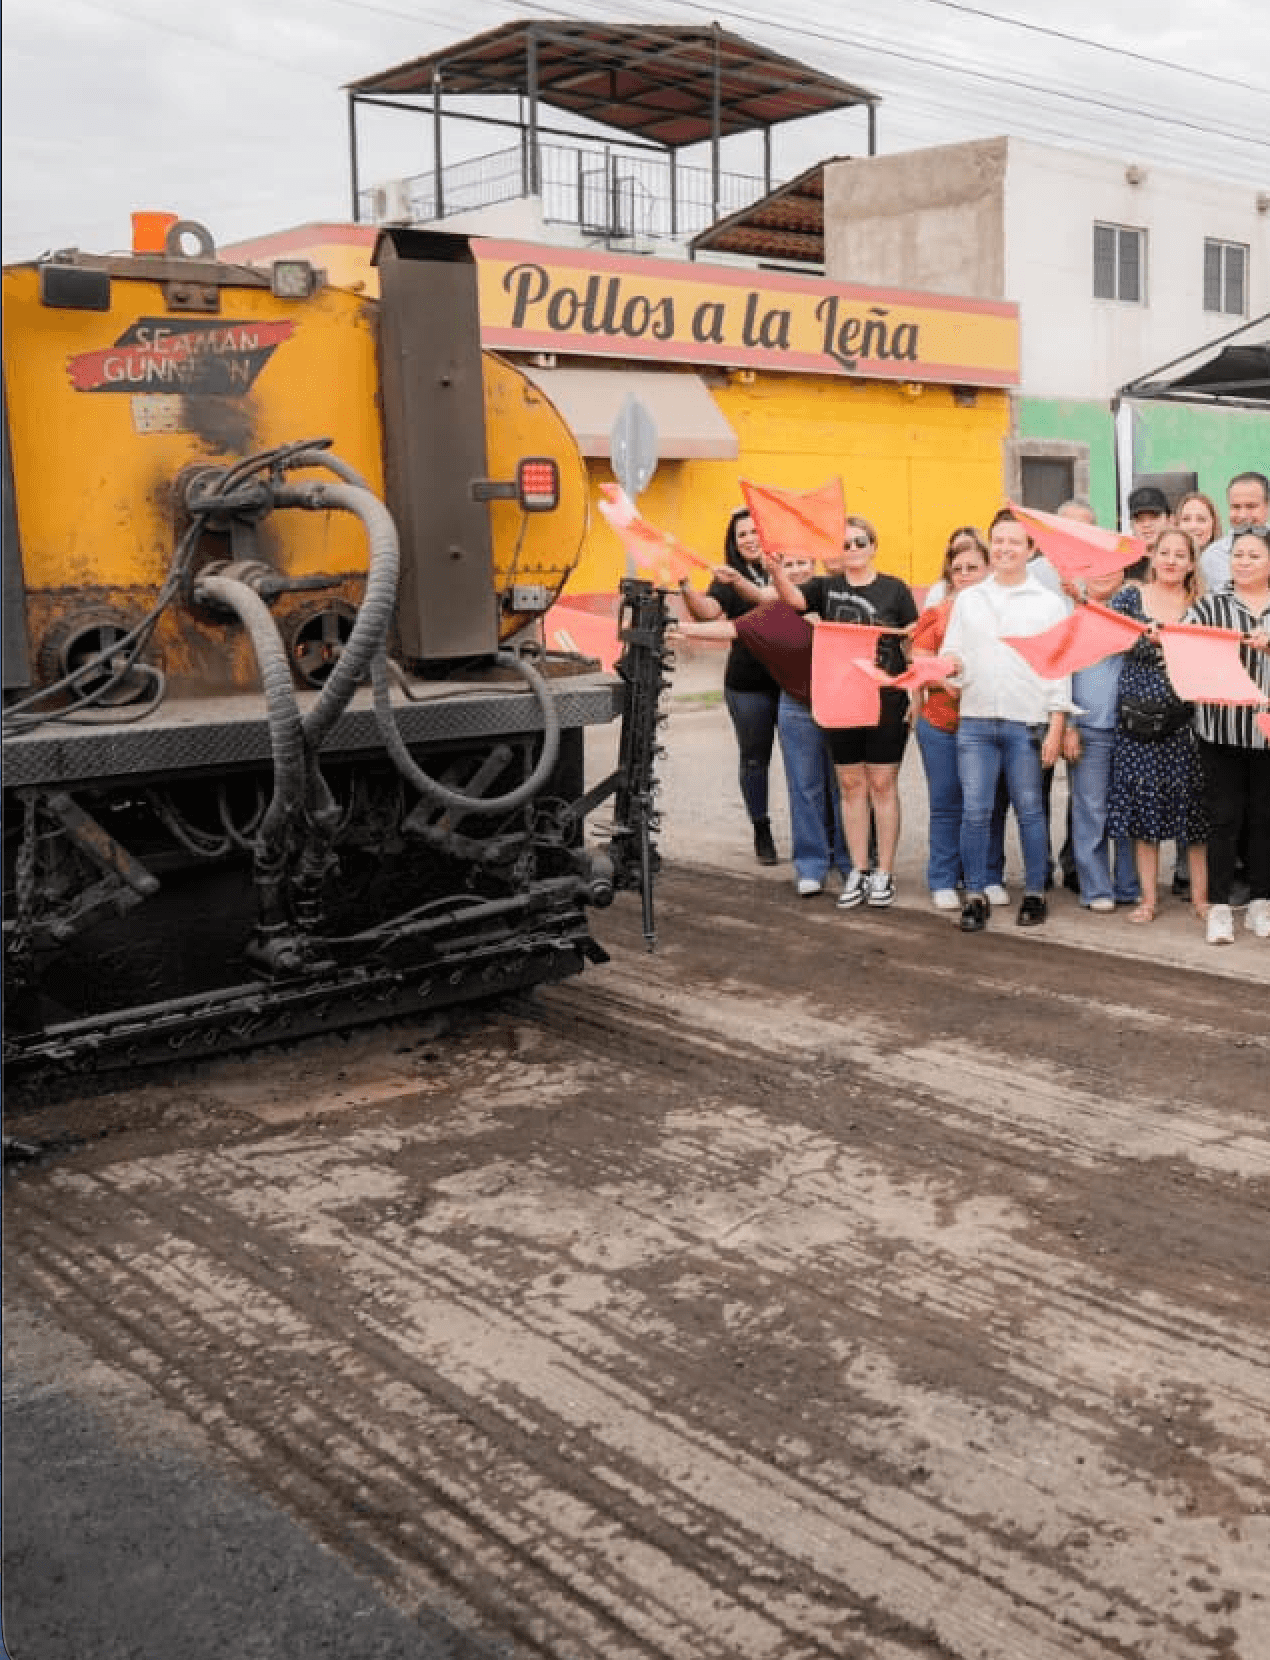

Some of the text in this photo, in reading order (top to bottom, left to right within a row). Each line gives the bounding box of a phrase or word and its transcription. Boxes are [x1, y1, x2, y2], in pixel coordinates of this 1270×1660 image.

[503, 263, 919, 371] Pollos a la Leña
